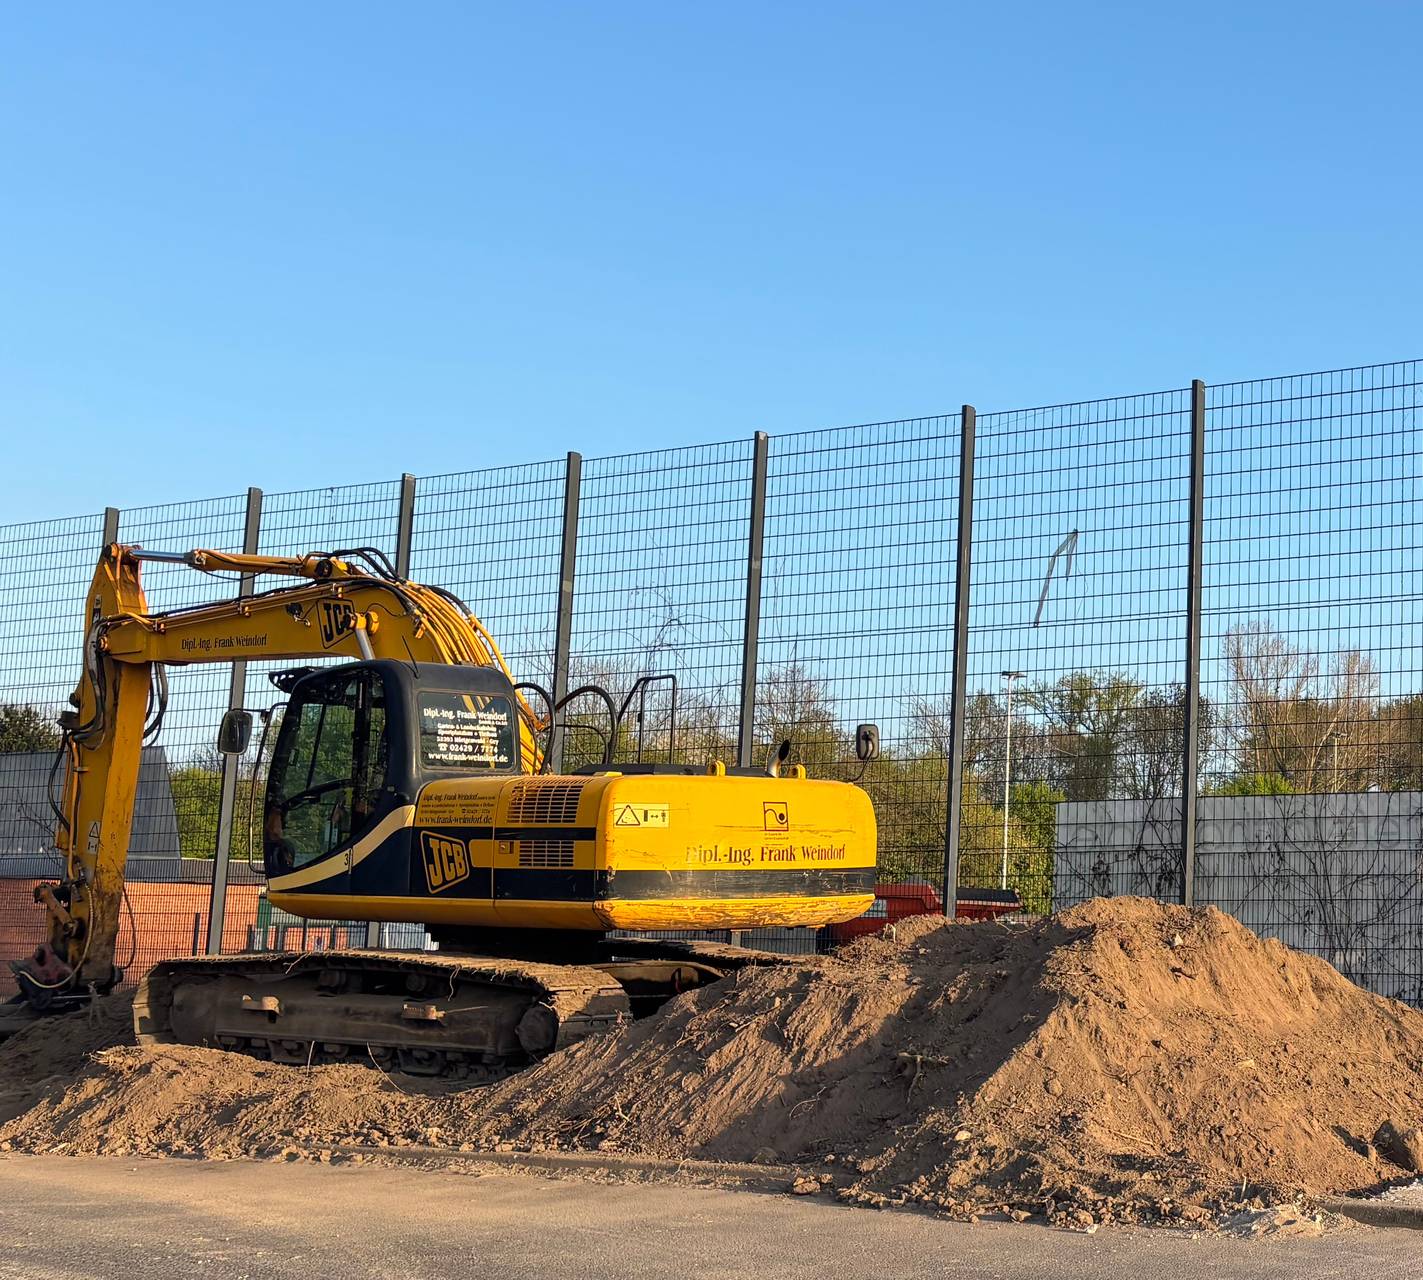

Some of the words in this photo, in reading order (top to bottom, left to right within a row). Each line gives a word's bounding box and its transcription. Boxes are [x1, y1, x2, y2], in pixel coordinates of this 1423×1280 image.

[181, 637, 212, 652] Dipl.-Ing.
[214, 636, 235, 648] Frank
[236, 633, 267, 647] Weindorf
[457, 710, 477, 719] Frank
[477, 711, 507, 721] Weindorf
[449, 744, 472, 752] 02429
[428, 752, 508, 763] www.frank-weindorf.de
[429, 838, 466, 887] JCB
[685, 844, 754, 867] Dipl.-Ing.
[760, 845, 797, 862] Frank
[801, 843, 846, 861] Weindorf
